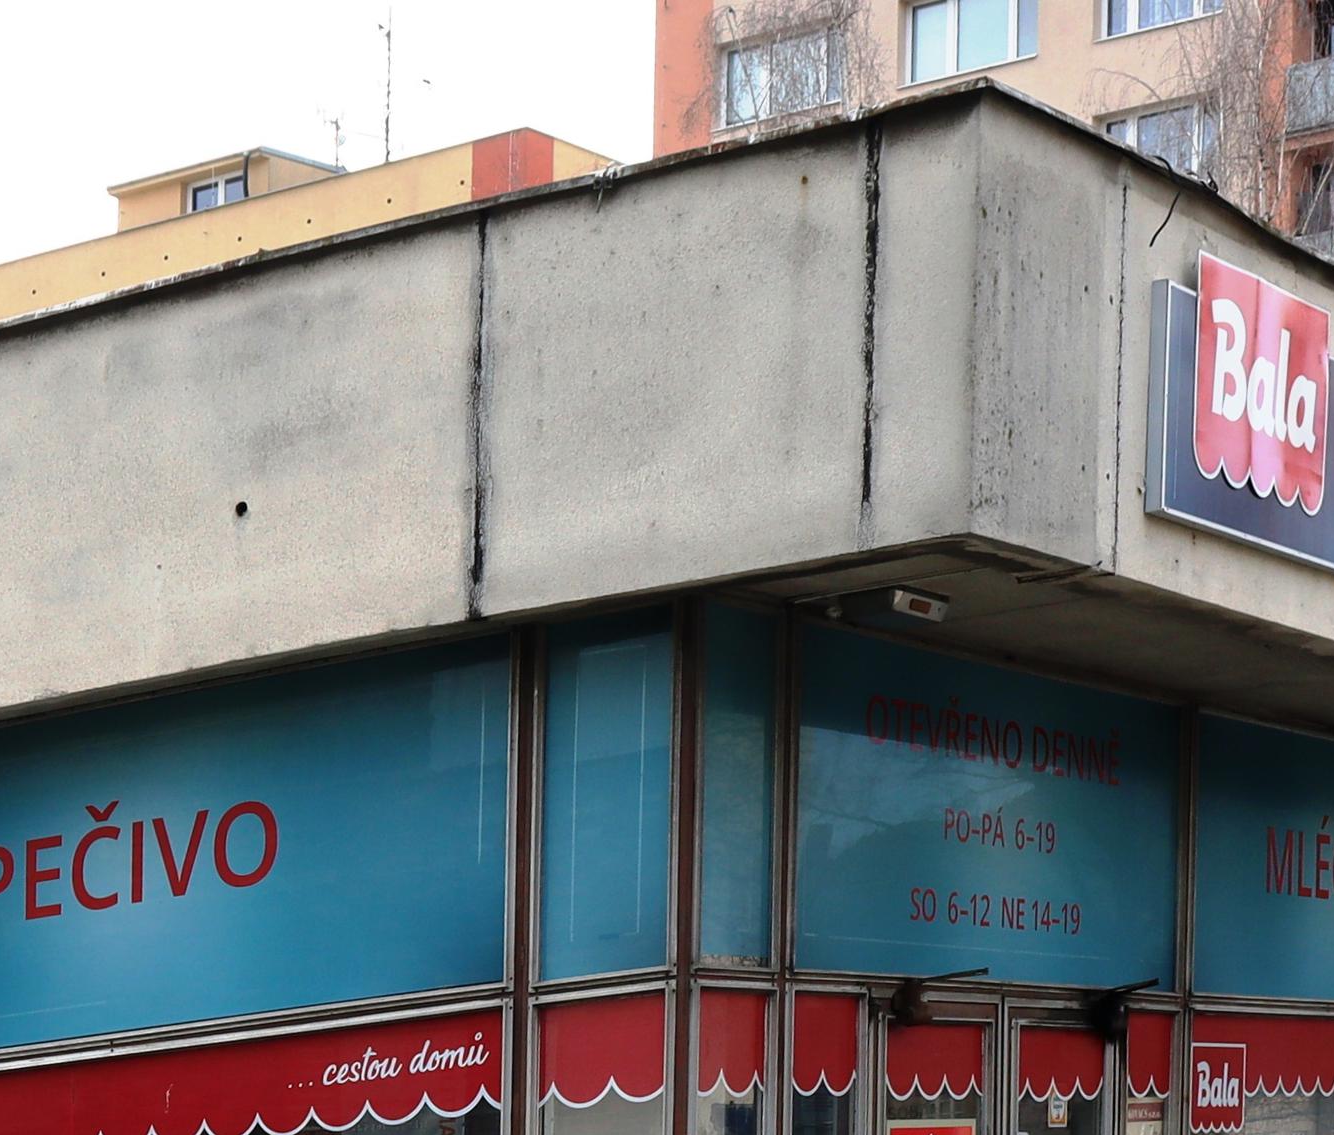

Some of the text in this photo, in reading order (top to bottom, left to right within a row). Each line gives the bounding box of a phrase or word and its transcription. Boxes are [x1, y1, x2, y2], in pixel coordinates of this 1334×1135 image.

[1210, 299, 1317, 453] Bala
[866, 695, 1120, 786] OTEVŘENO DENNĚ
[910, 887, 937, 922] SO
[1001, 897, 1025, 930] NE
[322, 1047, 403, 1086] cestou
[409, 1032, 490, 1075] domů
[1197, 1061, 1240, 1108] Bala
